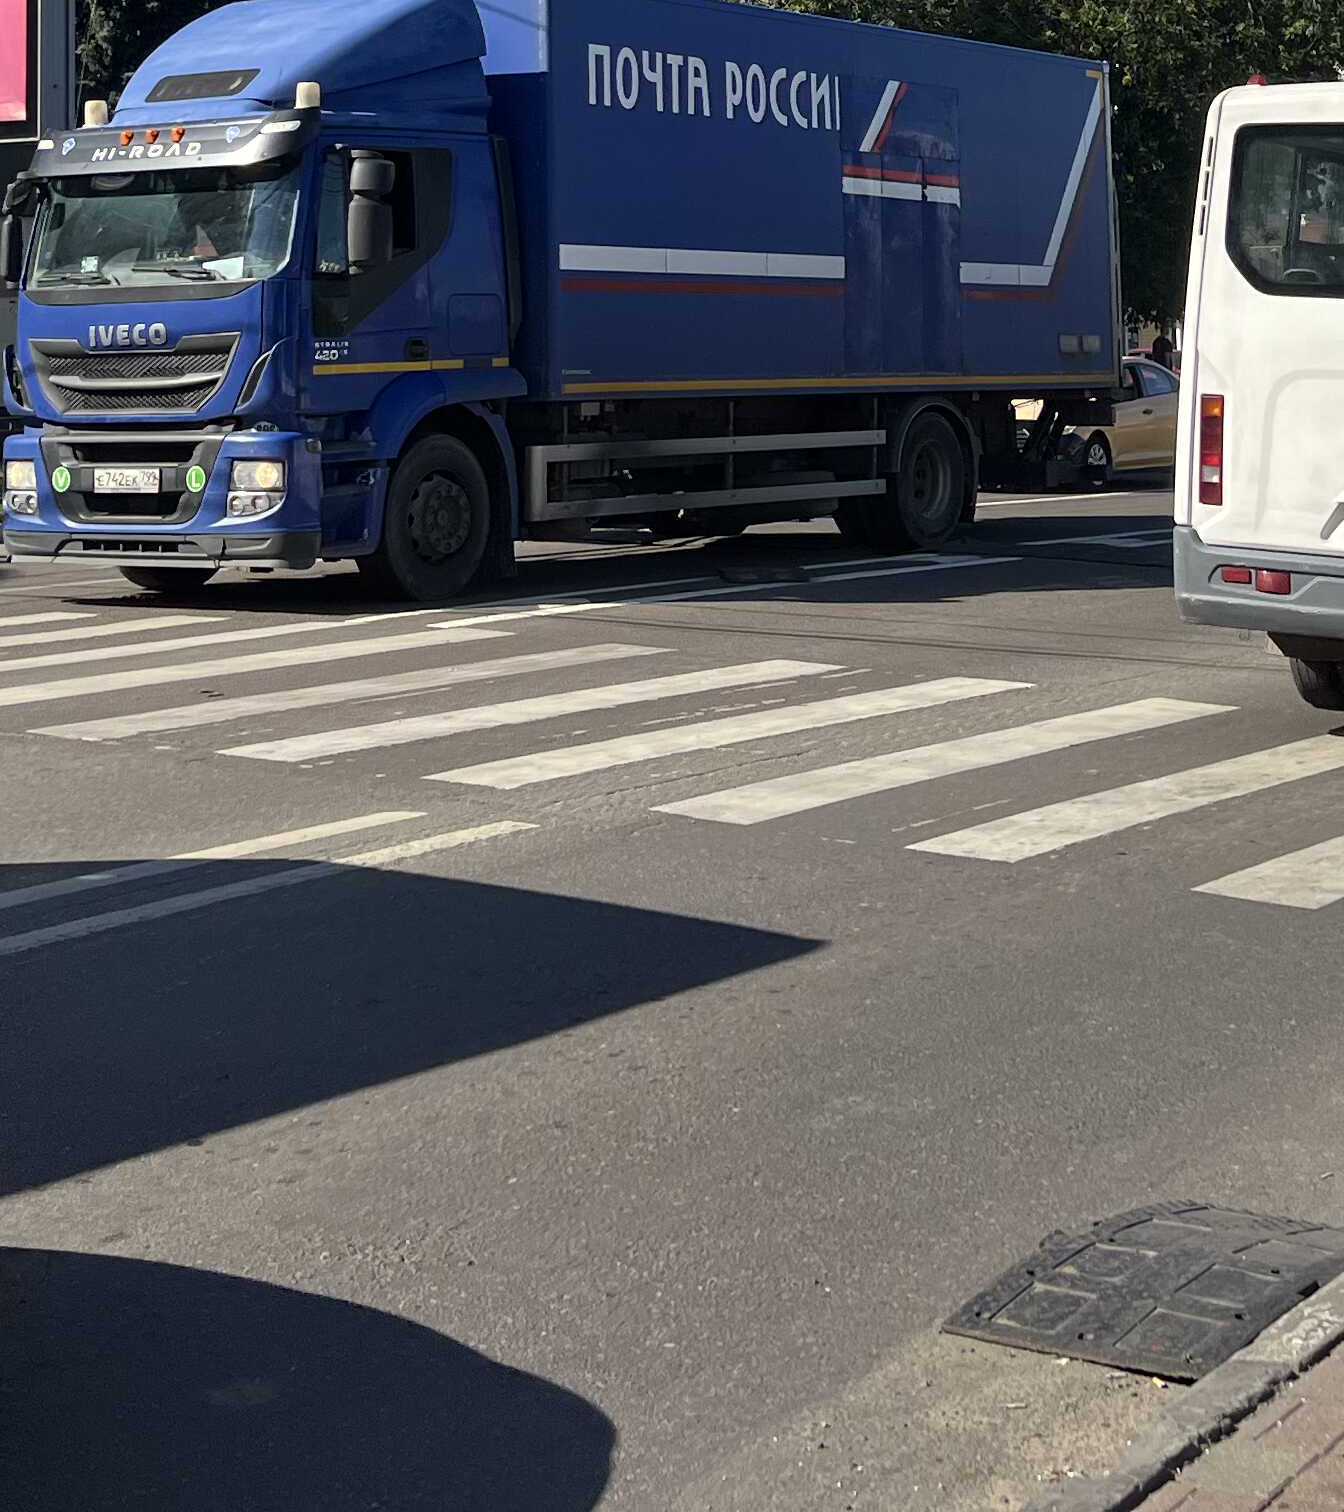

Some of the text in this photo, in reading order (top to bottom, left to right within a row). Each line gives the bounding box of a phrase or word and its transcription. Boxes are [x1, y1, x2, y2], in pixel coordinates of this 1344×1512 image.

[588, 43, 841, 131] ПОЧТА РОССИ
[91, 142, 202, 162] HI-ROAD
[88, 322, 168, 348] IVECO
